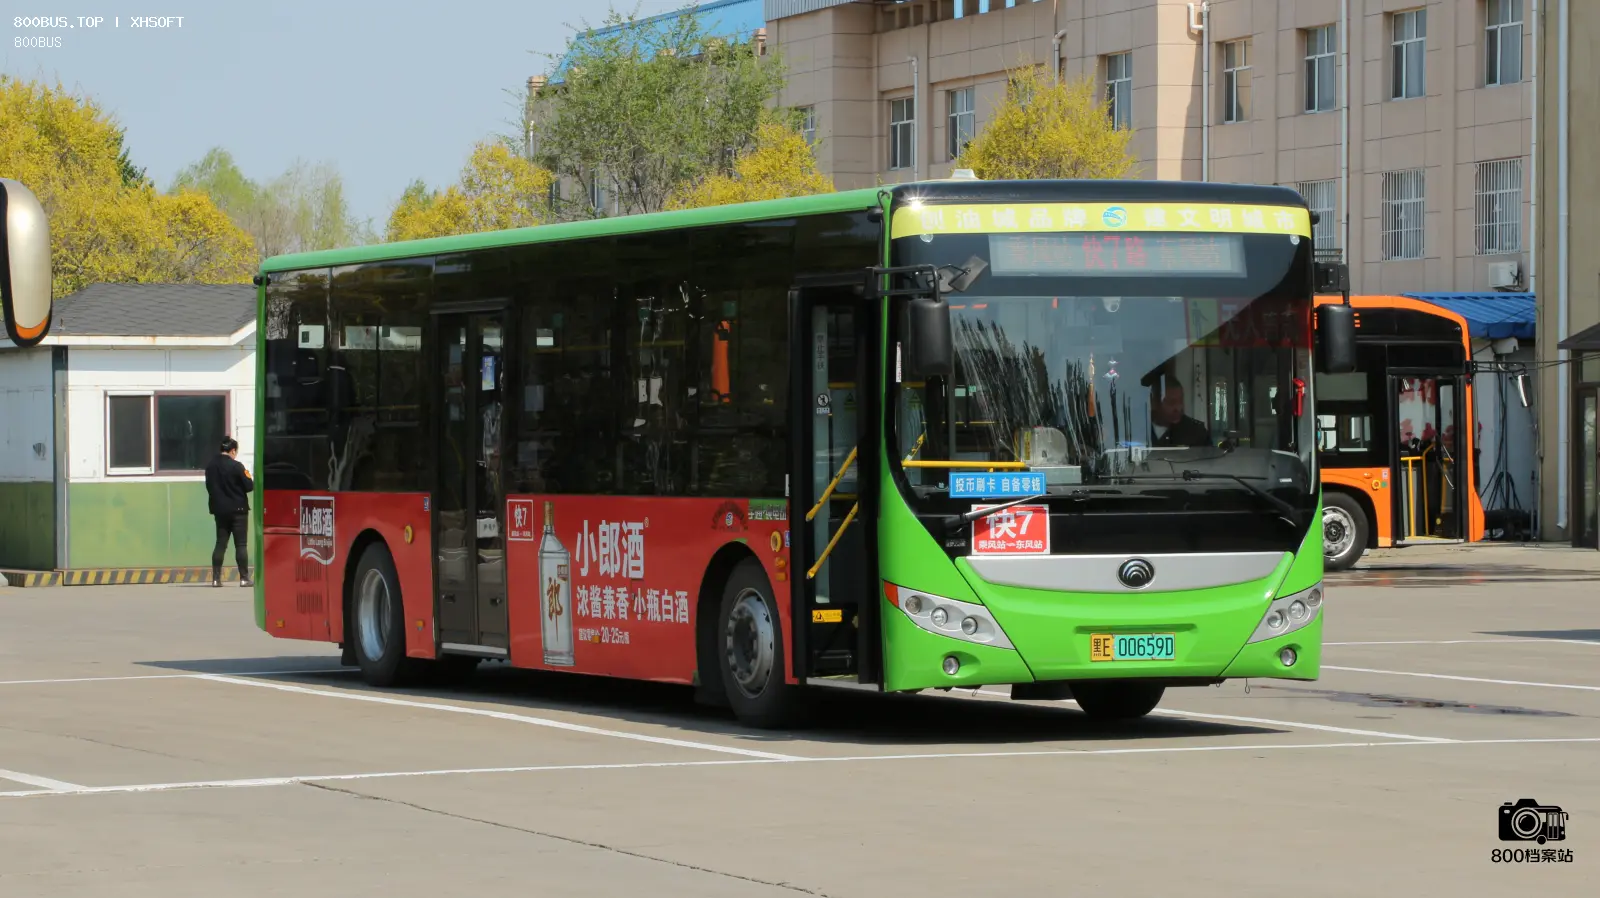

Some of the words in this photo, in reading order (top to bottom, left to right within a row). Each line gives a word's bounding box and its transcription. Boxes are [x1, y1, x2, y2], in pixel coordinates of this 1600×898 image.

[956, 477, 996, 493] 投币刷卡
[1001, 477, 1041, 493] 自备零钱
[514, 504, 528, 529] 快7
[986, 509, 1034, 539] 快7
[575, 519, 644, 578] 小郎酒
[576, 584, 629, 621] 浓酱兼香
[633, 587, 689, 624] 小瓶白酒
[1118, 636, 1174, 657] 00659D
